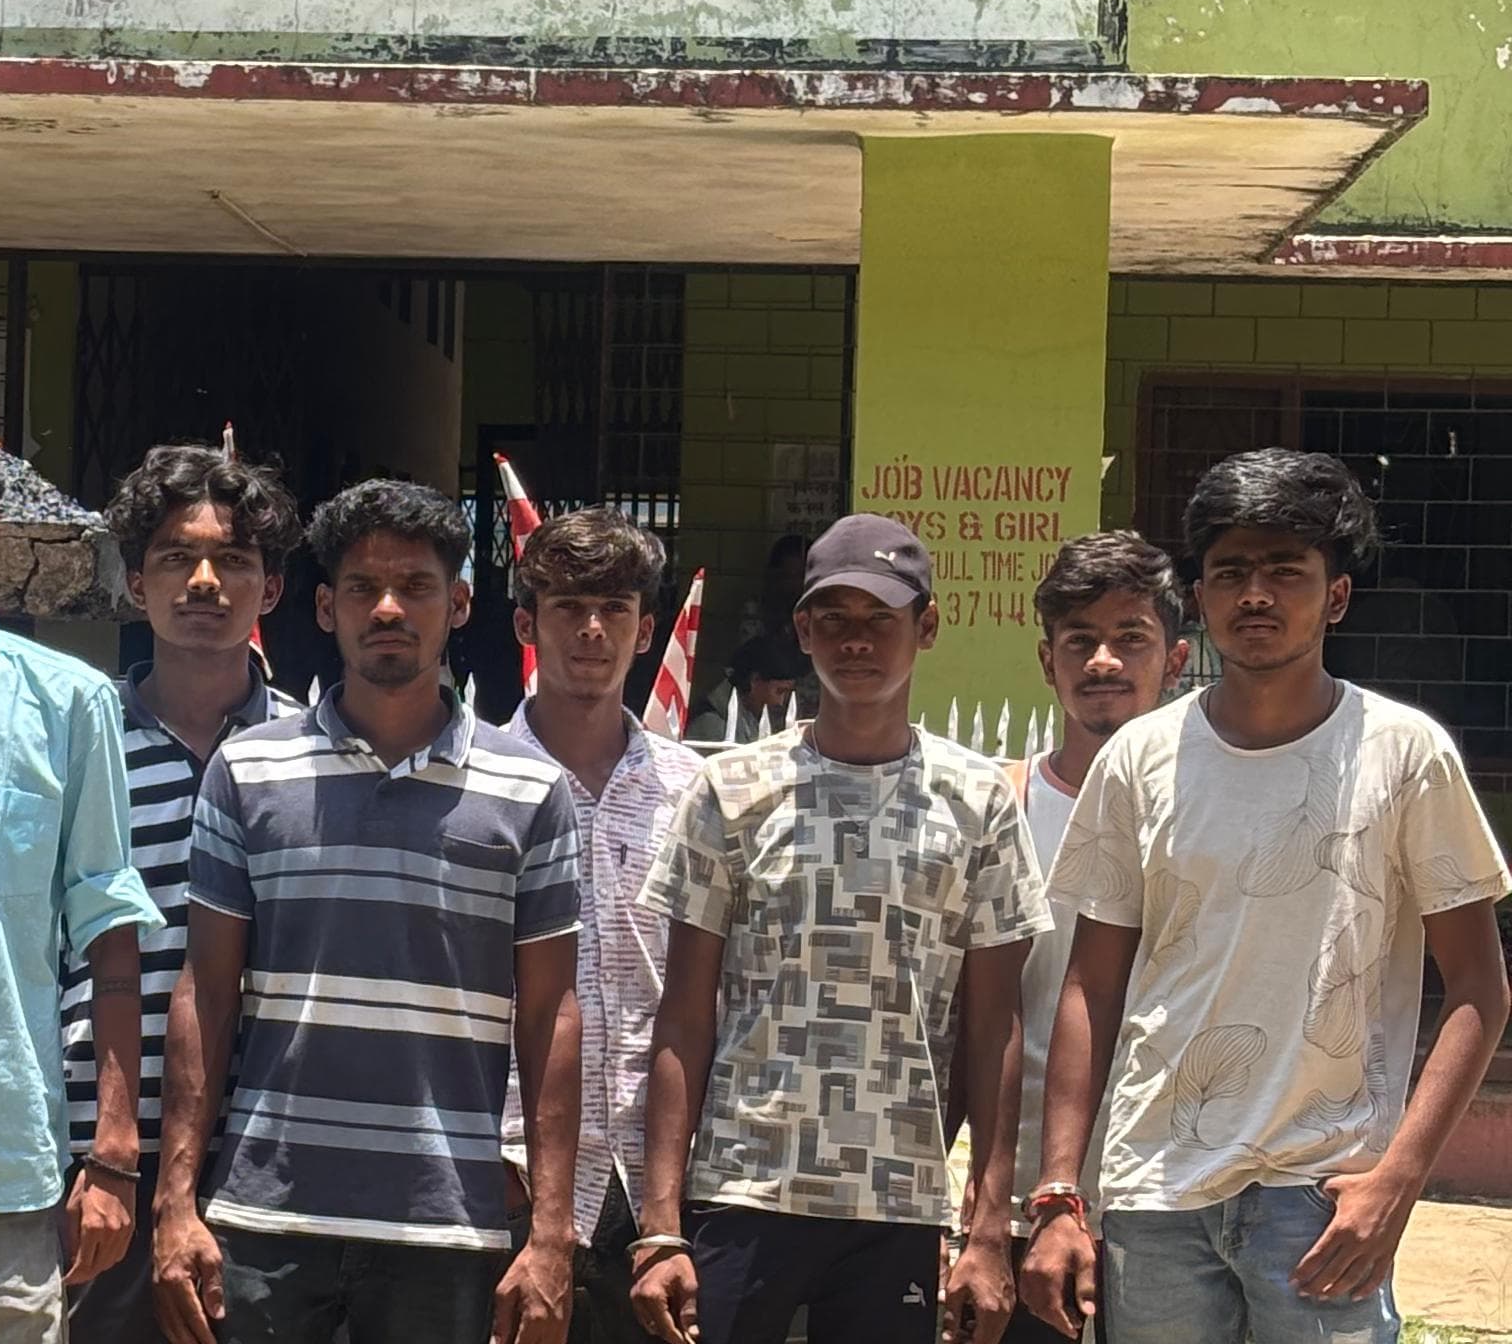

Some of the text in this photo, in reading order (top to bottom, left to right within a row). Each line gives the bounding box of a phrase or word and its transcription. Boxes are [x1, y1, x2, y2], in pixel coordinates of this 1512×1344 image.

[861, 463, 1073, 503] JOB VACANCY
[860, 511, 947, 542] YS
[958, 512, 983, 542] &
[980, 550, 1025, 582] TIME
[1031, 552, 1058, 582] JO
